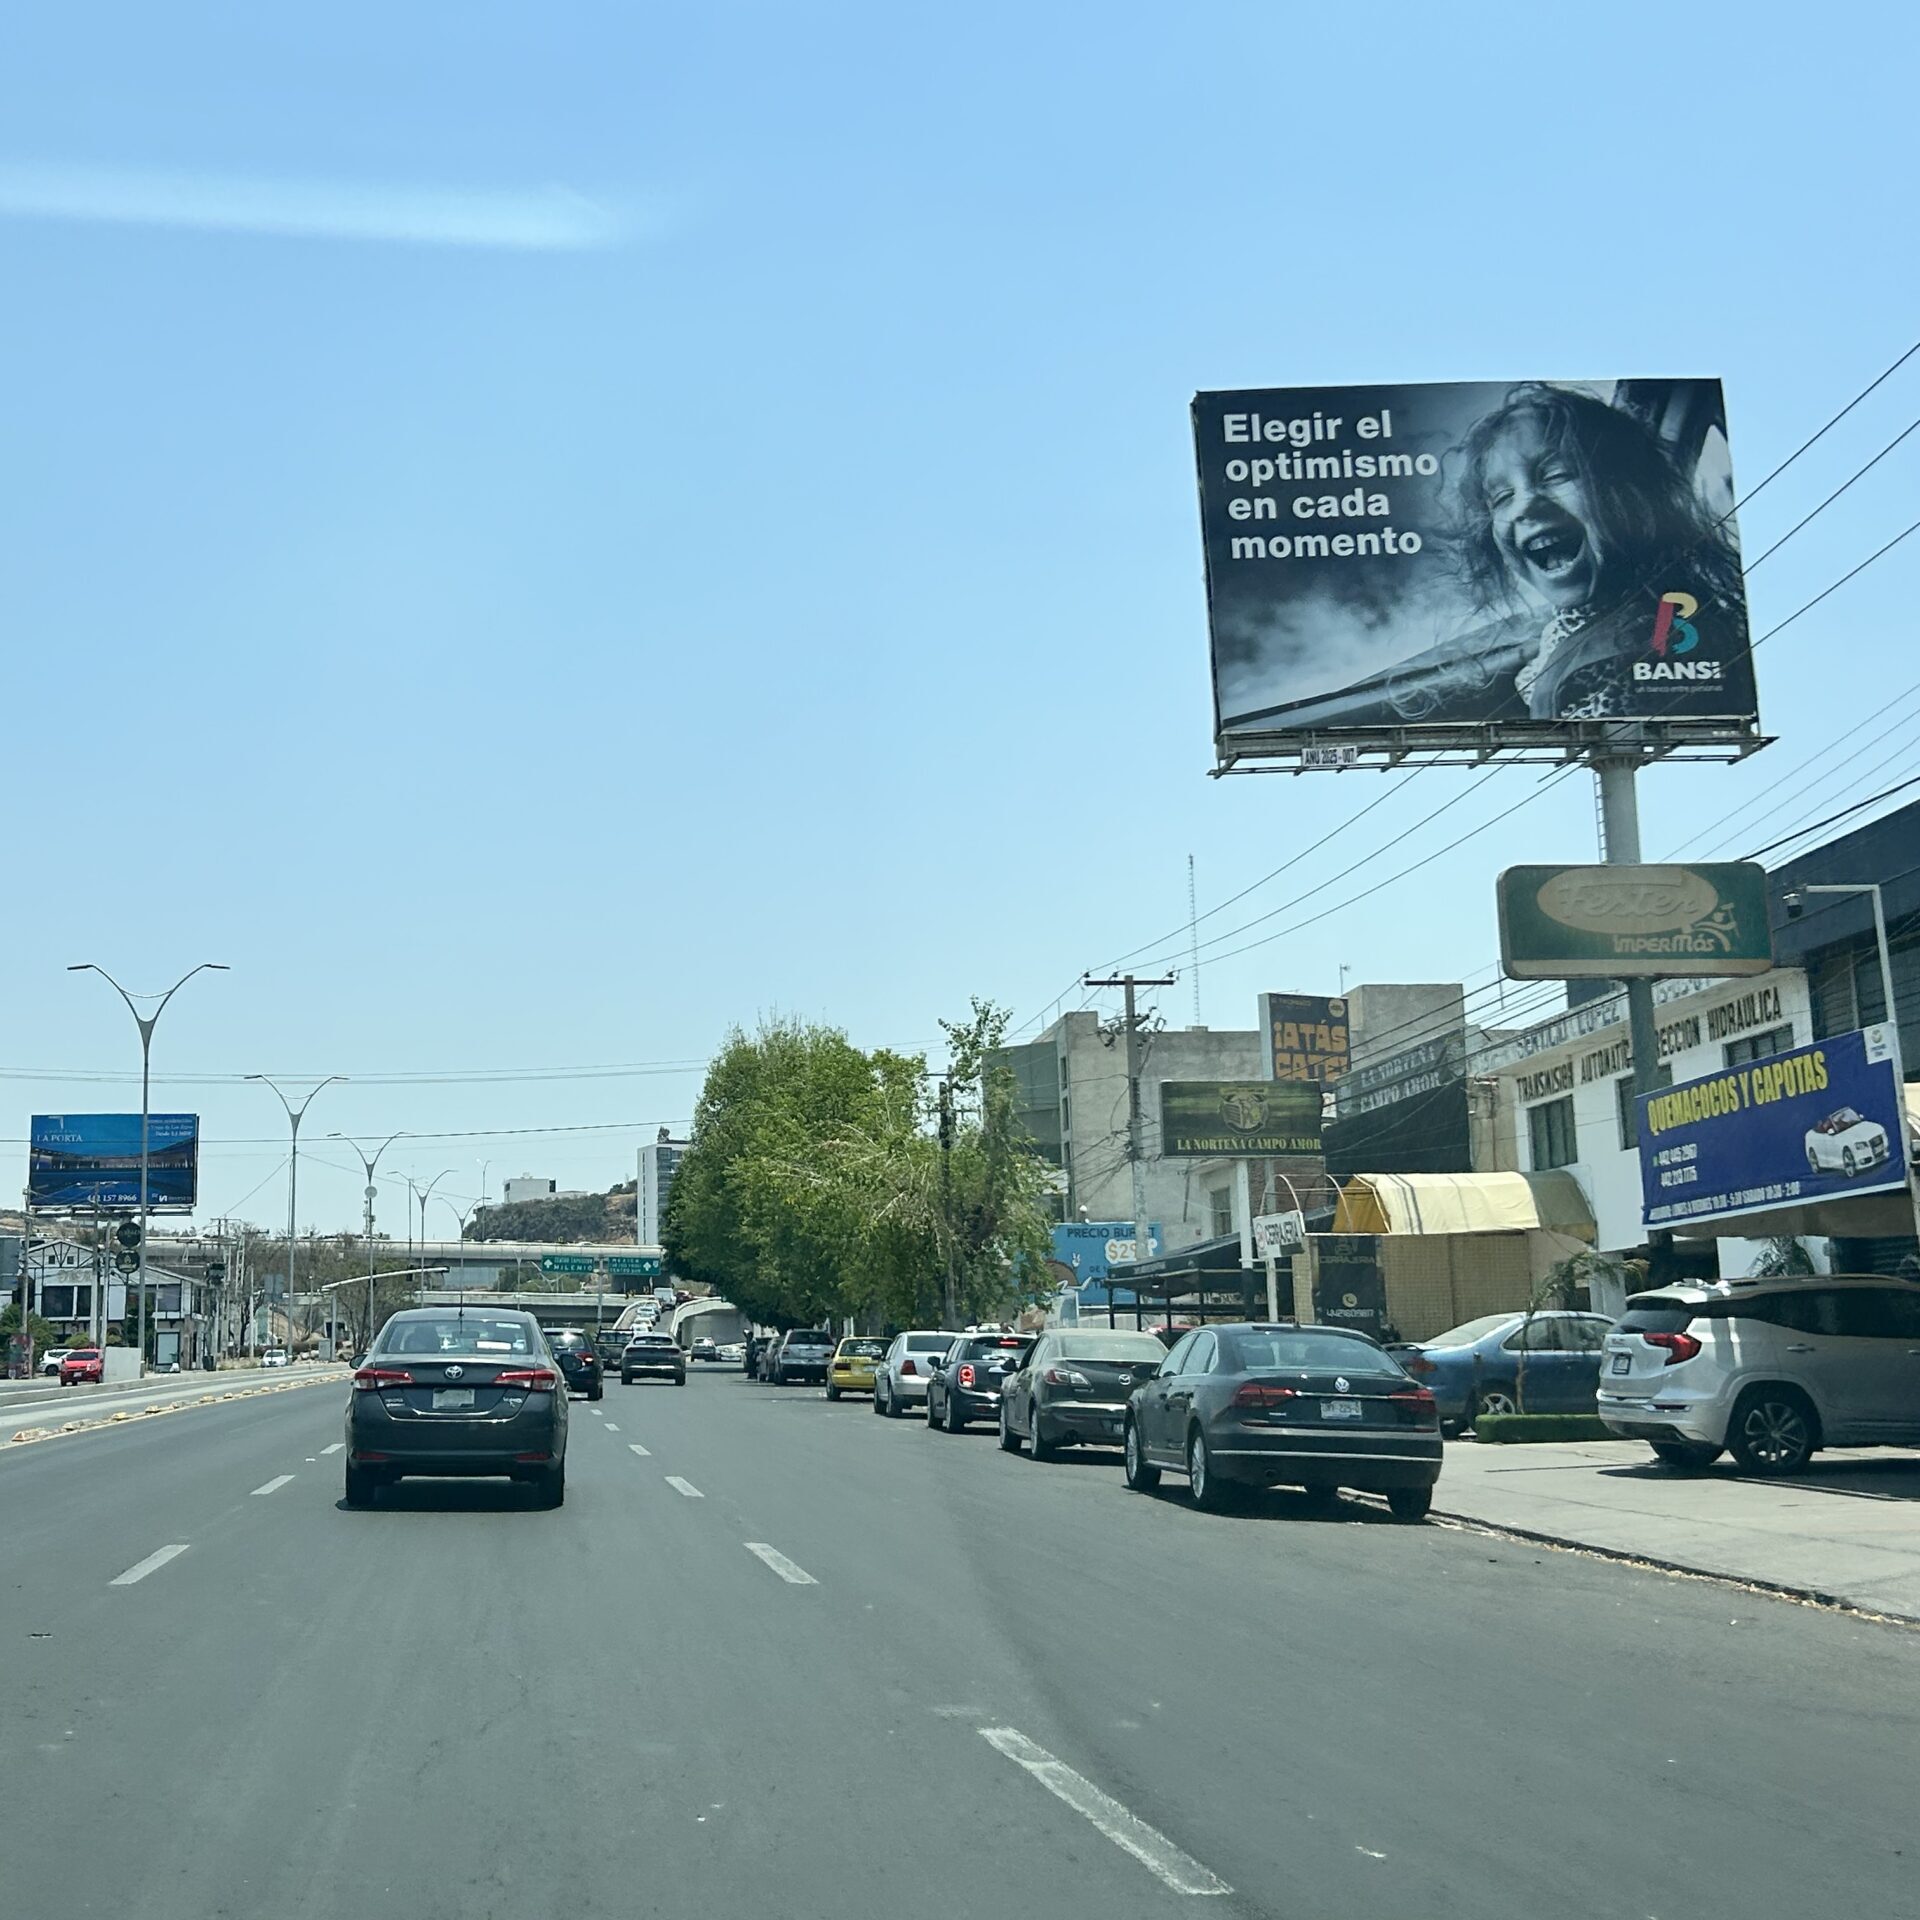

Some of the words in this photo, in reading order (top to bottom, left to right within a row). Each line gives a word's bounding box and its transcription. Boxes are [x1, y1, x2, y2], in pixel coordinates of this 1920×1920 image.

[1223, 411, 1343, 448] Elegir
[1356, 409, 1392, 439] el
[1225, 449, 1439, 487] optimismo
[1228, 496, 1277, 520] en
[1292, 488, 1390, 519] cada
[1231, 527, 1422, 559] momento
[1707, 986, 1783, 1042] HIDRAULICA
[1647, 1076, 1740, 1136] QUEMACOCOS
[1738, 1072, 1749, 1108] Y
[1752, 1051, 1828, 1105] CAPOTAS
[1177, 1139, 1191, 1150] LA
[1248, 1138, 1287, 1150] CAMPO
[1289, 1138, 1322, 1150] AMOR
[1067, 1228, 1110, 1238] PRECIO
